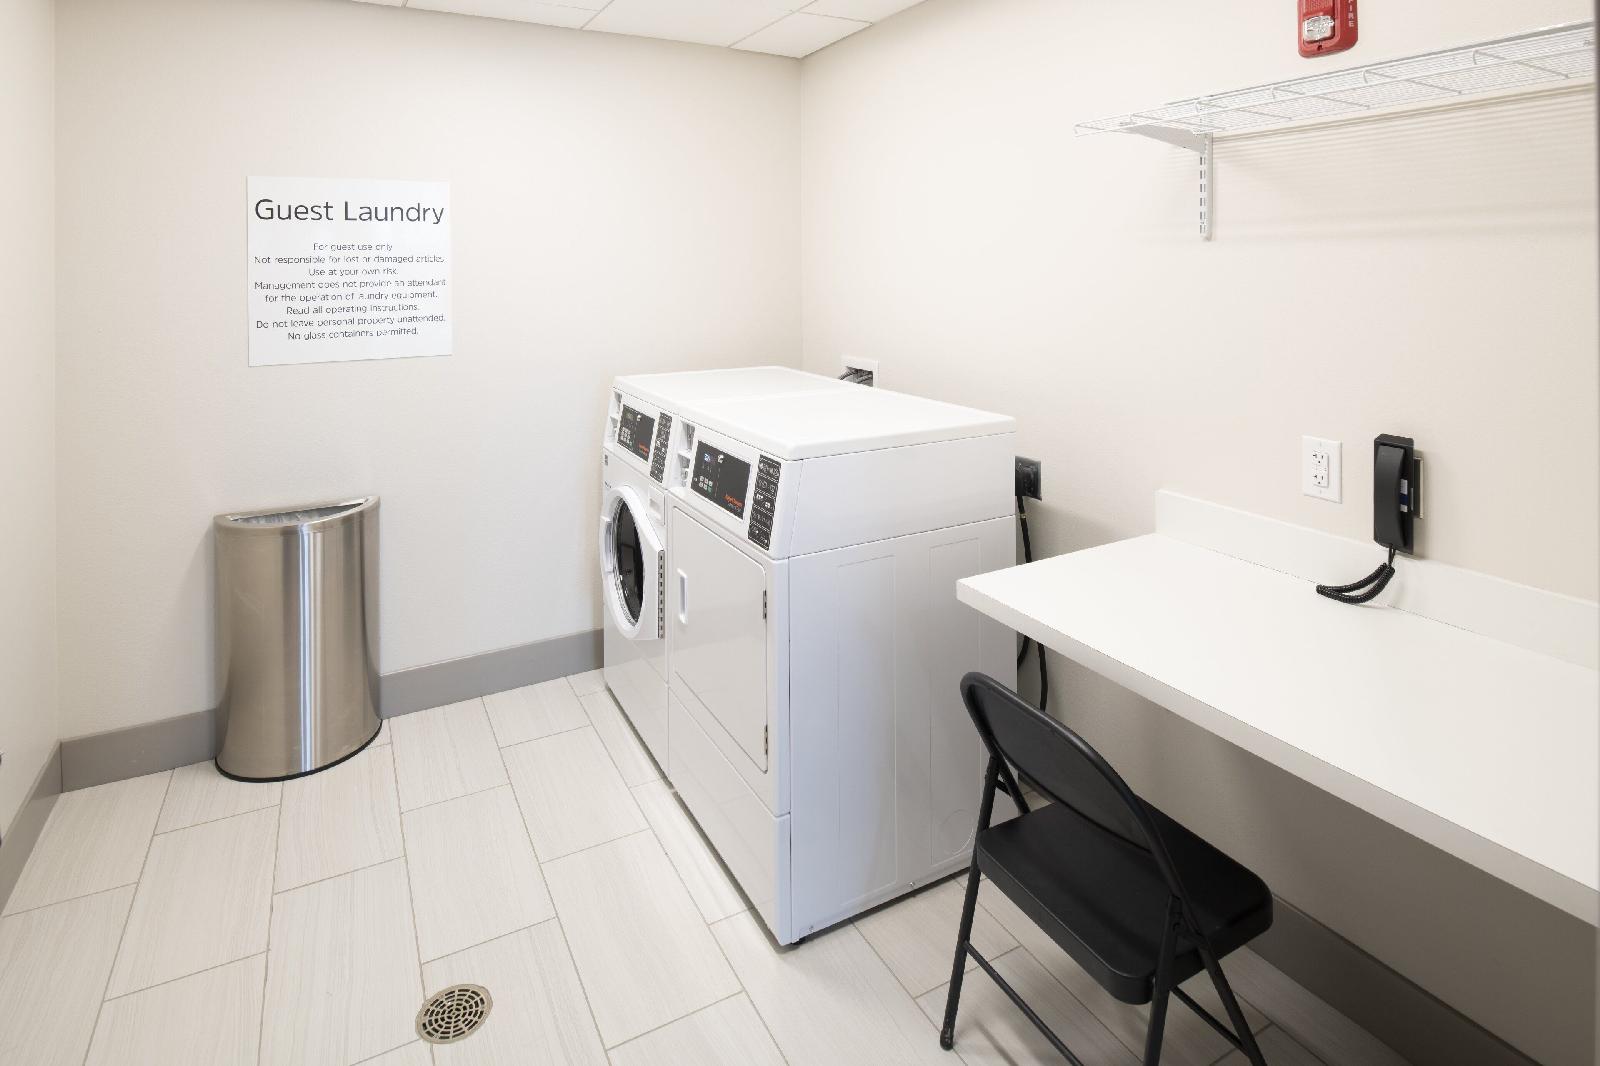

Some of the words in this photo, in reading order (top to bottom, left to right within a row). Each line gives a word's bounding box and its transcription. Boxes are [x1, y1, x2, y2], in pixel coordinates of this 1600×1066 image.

[254, 198, 334, 221] Guest
[344, 200, 445, 225] Laundry
[313, 243, 329, 251] For
[330, 243, 355, 252] guest
[357, 243, 373, 251] use
[254, 255, 271, 264] Not
[274, 255, 326, 265] responsible
[328, 255, 341, 263] for
[343, 255, 359, 263] lost
[373, 255, 414, 264] damaged
[308, 267, 326, 276] Use
[328, 268, 337, 276] at
[339, 268, 359, 277] your
[382, 267, 399, 275] risk.
[254, 281, 316, 291] Management
[317, 280, 340, 289] does
[342, 280, 358, 288] not
[264, 294, 279, 303] for
[281, 293, 297, 302] the
[345, 292, 355, 301] of
[357, 291, 389, 301] aundry
[286, 306, 310, 315] Read
[312, 305, 324, 314] all
[325, 304, 367, 314] operating
[256, 320, 269, 329] Do
[272, 319, 289, 328] not
[290, 319, 315, 327] leave
[317, 317, 356, 327] personal
[357, 315, 395, 326] property
[287, 332, 301, 340] No
[303, 331, 327, 341] glass
[328, 329, 374, 339] containers
